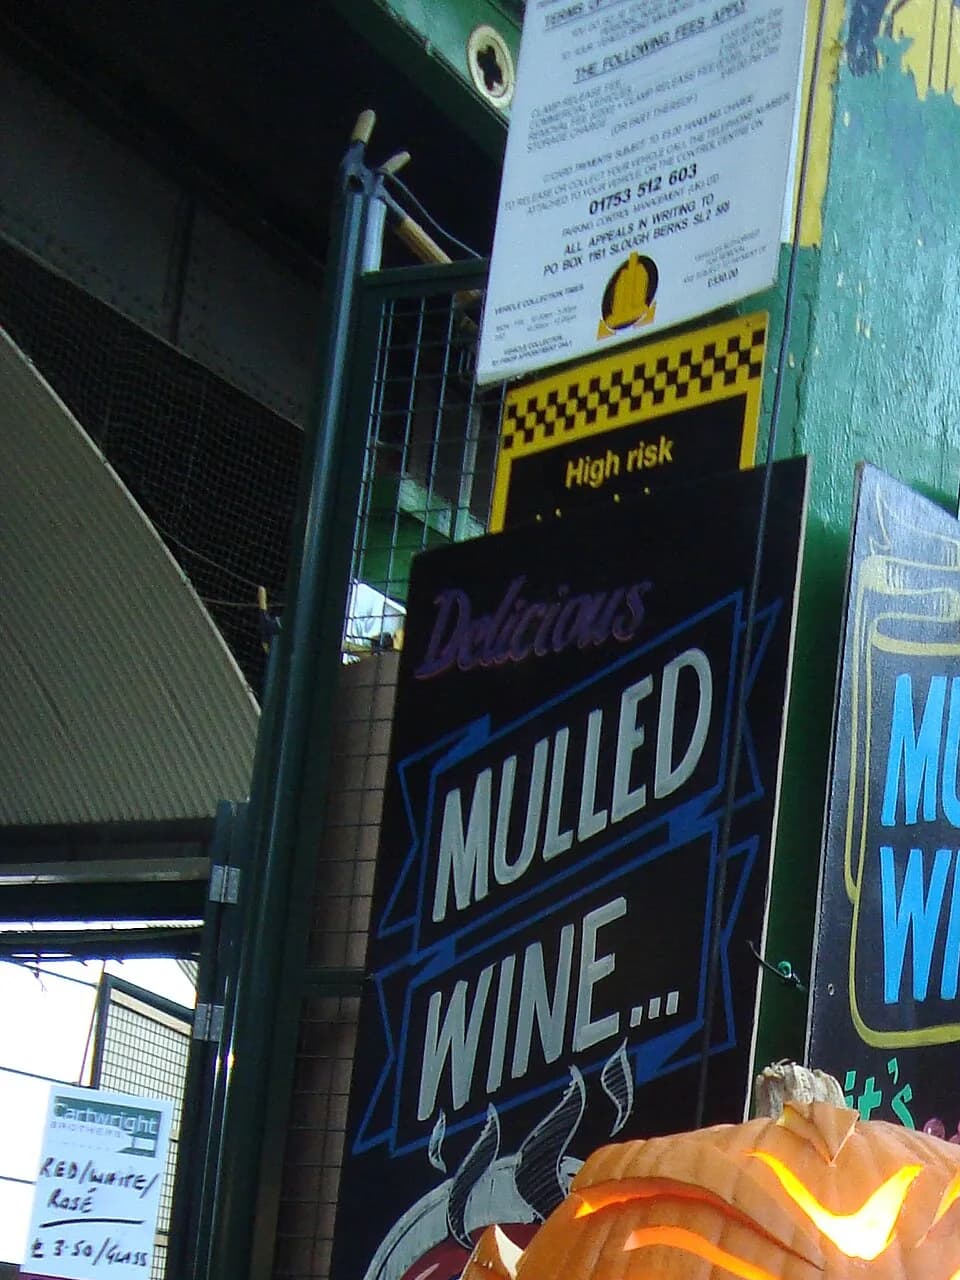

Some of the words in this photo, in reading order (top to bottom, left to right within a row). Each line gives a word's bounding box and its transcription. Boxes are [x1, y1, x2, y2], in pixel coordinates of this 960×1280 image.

[574, 59, 597, 81] THE
[602, 32, 669, 68] FOLLOWING
[674, 16, 704, 40] FEES
[588, 188, 631, 215] 01753
[637, 176, 662, 197] 512
[668, 163, 697, 185] 603
[543, 262, 557, 276] PO
[562, 254, 582, 271] BOX
[609, 231, 650, 254] SLOUGH
[653, 217, 688, 238] BERKS
[563, 239, 581, 256] ALL
[588, 222, 634, 246] APPEALS
[637, 216, 647, 229] IN
[652, 200, 695, 223] WRITING
[702, 192, 713, 207] TO
[565, 450, 620, 488] High
[626, 435, 674, 471] risk
[414, 574, 654, 680] Delicious
[432, 647, 713, 923] MULLED
